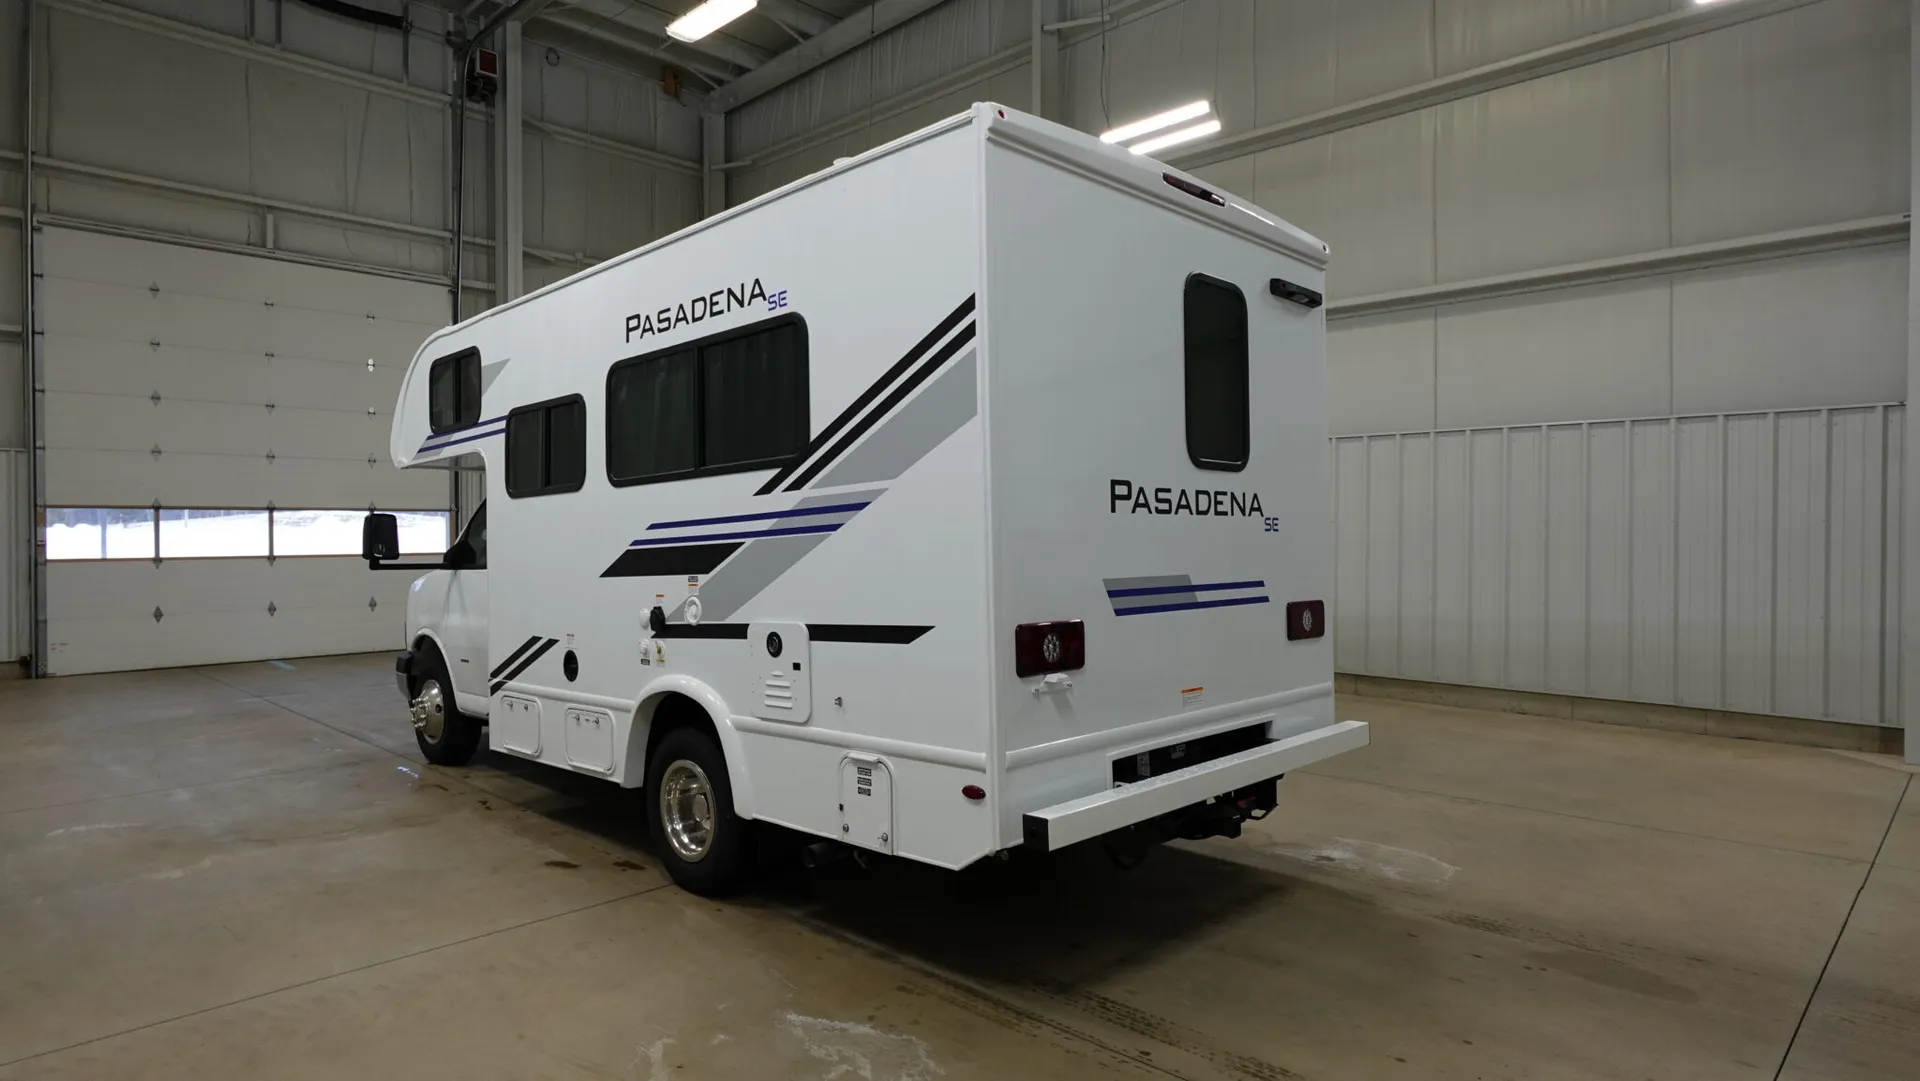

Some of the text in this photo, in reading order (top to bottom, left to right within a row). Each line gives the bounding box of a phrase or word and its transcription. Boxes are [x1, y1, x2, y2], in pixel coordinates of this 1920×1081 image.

[625, 277, 788, 343] PASADENA SE
[1110, 479, 1279, 532] PASADENA SE
